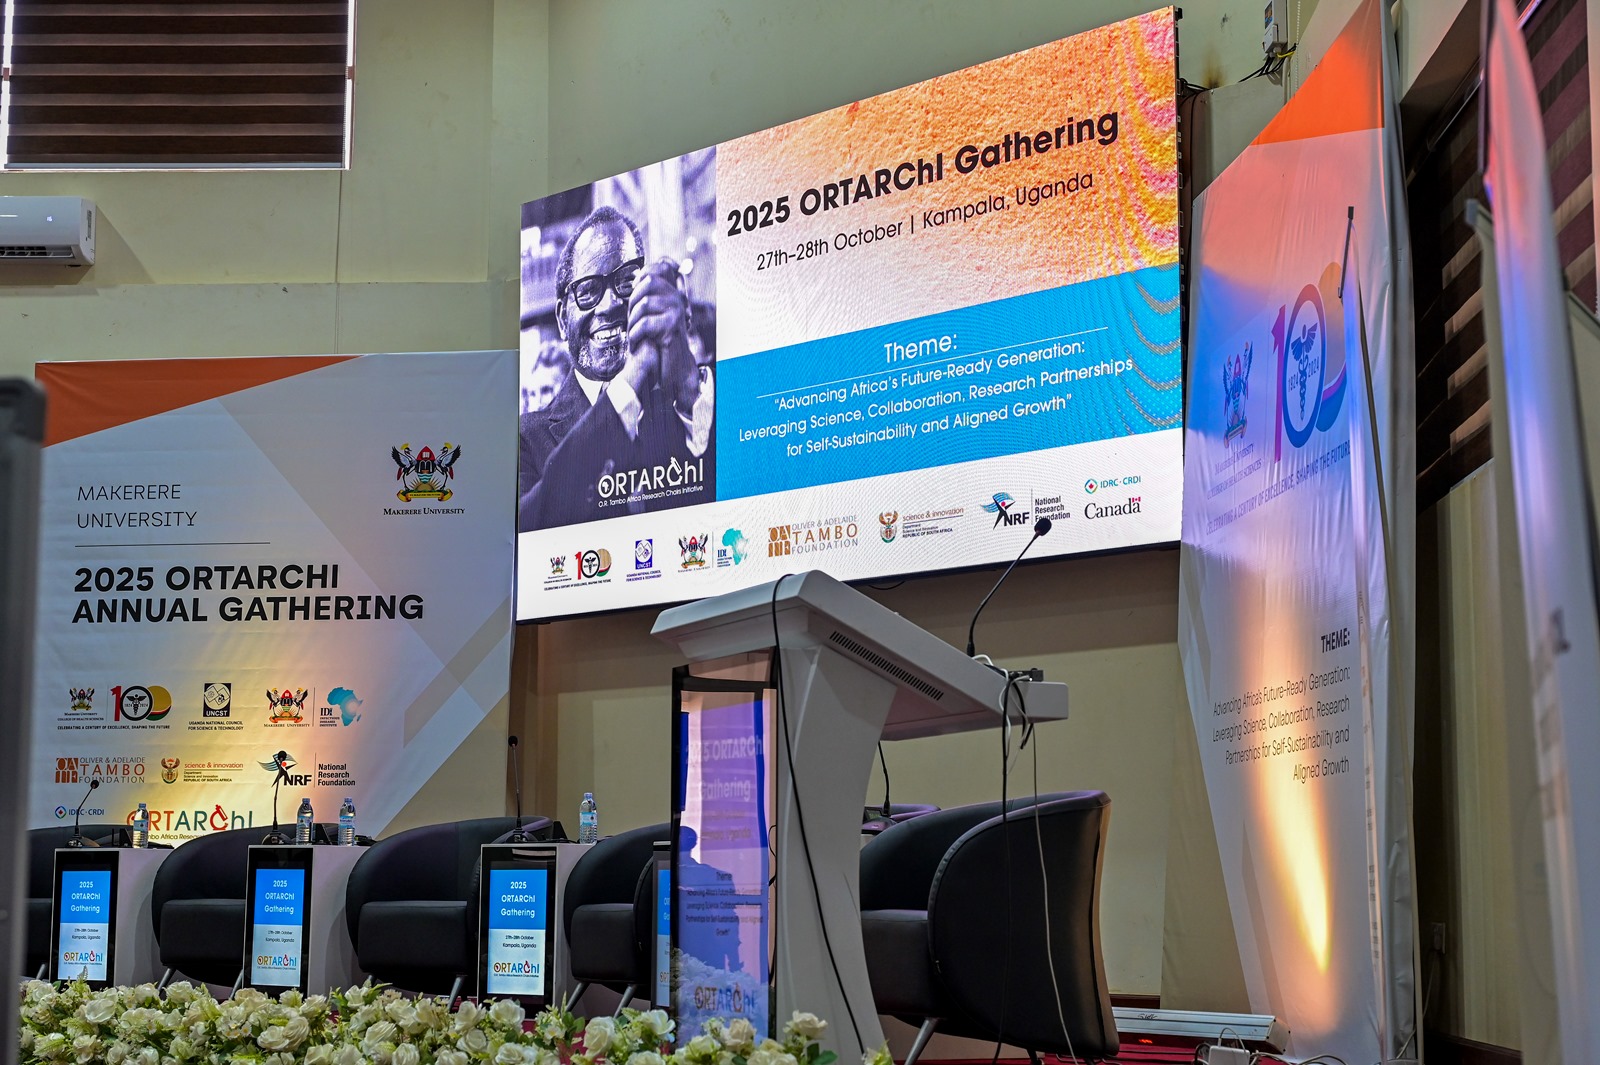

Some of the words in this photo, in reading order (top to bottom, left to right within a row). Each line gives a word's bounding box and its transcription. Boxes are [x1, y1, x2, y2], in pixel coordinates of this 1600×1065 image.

[726, 195, 791, 237] 2025
[800, 158, 944, 217] ORTARChI
[954, 112, 1120, 174] Gathering
[834, 220, 904, 252] October
[922, 196, 1011, 230] Kampala,
[1014, 171, 1094, 208] Uganda
[884, 333, 958, 364] Theme:
[901, 358, 993, 389] Future-Ready
[997, 340, 1086, 369] Generation:
[738, 417, 808, 442] Leveraging
[810, 408, 866, 431] Science,
[868, 392, 966, 419] Collaboration,
[968, 377, 1036, 400] Research
[1040, 356, 1134, 389] Partnerships
[786, 440, 804, 458] for
[806, 422, 918, 454] Self-Sustainability
[920, 416, 950, 435] and
[952, 404, 1009, 432] Aligned
[77, 484, 182, 502] MAKERERE
[642, 491, 666, 500] Research
[682, 484, 704, 494] Initiative
[1100, 478, 1118, 489] IDRC
[1122, 476, 1142, 485] CRDI
[1034, 496, 1061, 506] National
[1206, 509, 1233, 536] CELEBRATING
[1238, 494, 1258, 518] CENTURY
[1265, 473, 1296, 503] EXCELLENCE,
[1296, 459, 1318, 485] SHAPING
[1320, 452, 1330, 471] THE
[76, 511, 198, 529] UNIVERSITY
[932, 508, 964, 517] innovation
[1004, 512, 1030, 526] NRF
[1034, 504, 1064, 514] Research
[1084, 498, 1142, 520] Canada
[792, 521, 815, 530] OLIVER
[816, 520, 822, 528] &
[824, 514, 858, 526] ADELAIDE
[792, 523, 858, 545] TAMBO
[792, 538, 858, 554] FOUNDATION
[74, 566, 154, 593] 2025
[165, 564, 339, 591] ORTARCHI
[72, 598, 208, 624] ANNUAL
[218, 595, 424, 623] GATHERING
[1321, 627, 1350, 653] THEME:
[1213, 698, 1242, 717] Advancing
[1264, 676, 1308, 702] Future-Ready
[1309, 666, 1350, 690] Generation:
[1213, 723, 1242, 743] Leveraging
[1243, 716, 1268, 738] Science,
[1268, 703, 1315, 730] Collaboration,
[1317, 694, 1350, 718] Research
[1226, 746, 1262, 765] Partnerships
[1262, 742, 1272, 758] for
[1272, 728, 1333, 756] Self-Sustainability
[1334, 725, 1350, 744] and
[80, 764, 145, 776] TAMBO
[284, 775, 312, 786] NRF
[1293, 760, 1320, 784] Aligned
[1322, 756, 1350, 777] Growth
[70, 905, 100, 913] Gathering
[264, 905, 294, 914] Gathering
[500, 908, 535, 918] Gathering
